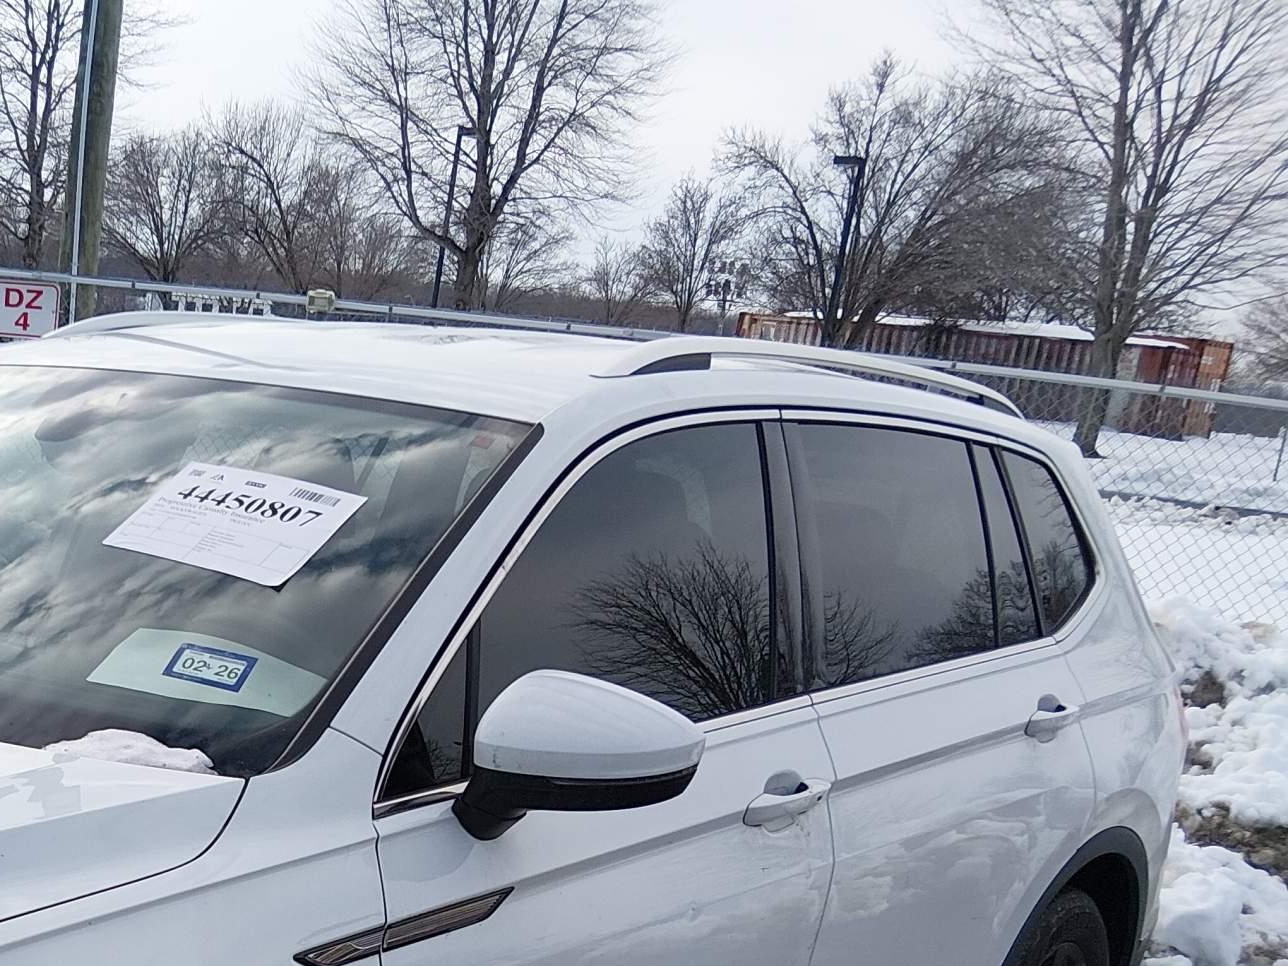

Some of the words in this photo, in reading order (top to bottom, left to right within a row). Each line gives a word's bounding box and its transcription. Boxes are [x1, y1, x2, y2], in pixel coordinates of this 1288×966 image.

[4, 288, 43, 310] DZ
[14, 312, 30, 331] 4
[177, 485, 324, 527] 44450807
[182, 657, 207, 673] 02
[214, 664, 241, 680] 26
